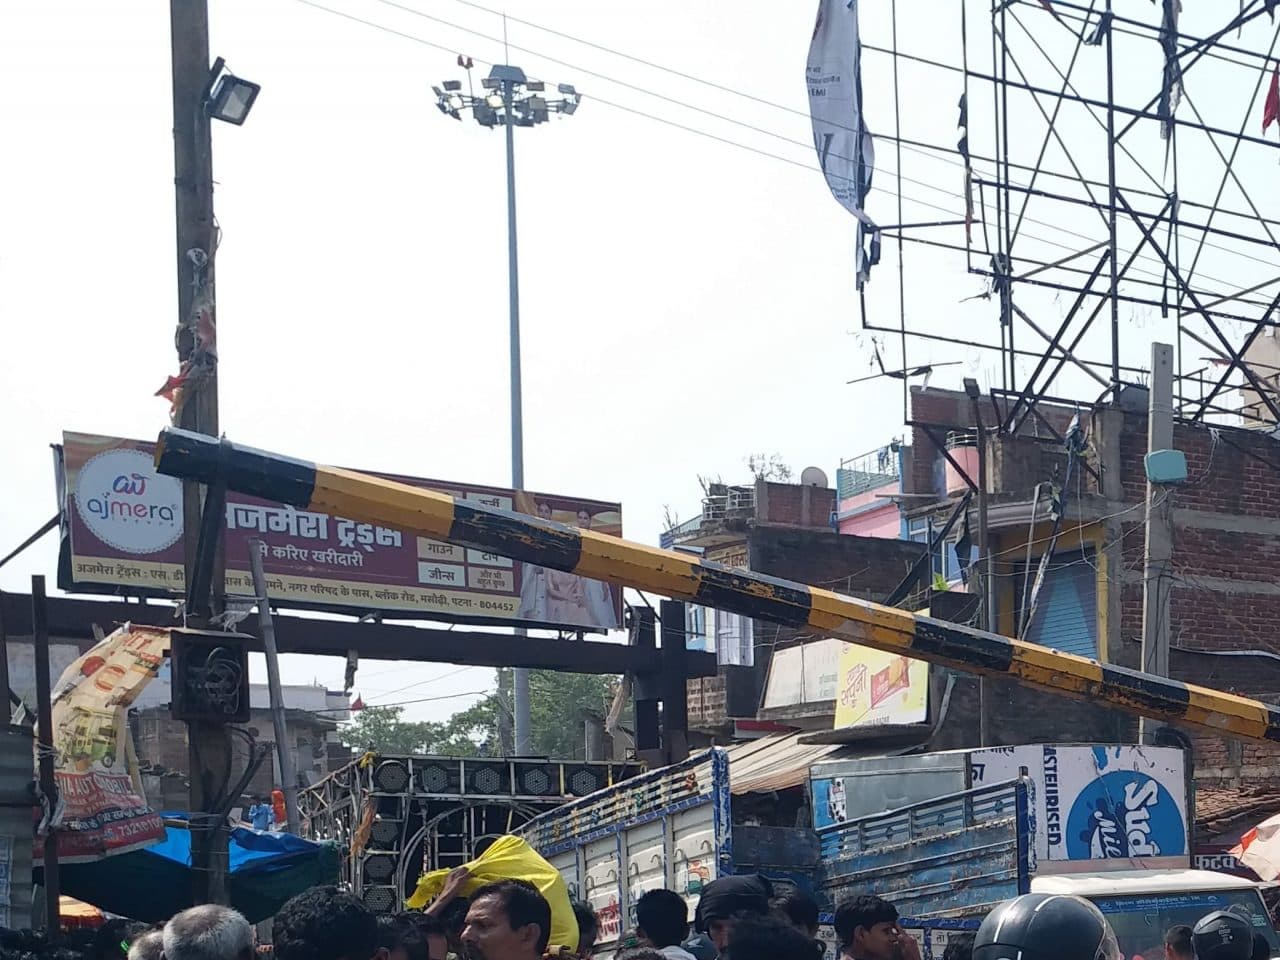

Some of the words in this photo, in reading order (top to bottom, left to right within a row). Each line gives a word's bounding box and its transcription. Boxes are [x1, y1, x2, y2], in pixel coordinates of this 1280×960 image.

[87, 492, 174, 520] ajmera
[225, 502, 329, 540] जमेरा
[312, 548, 364, 567] खरीदारी
